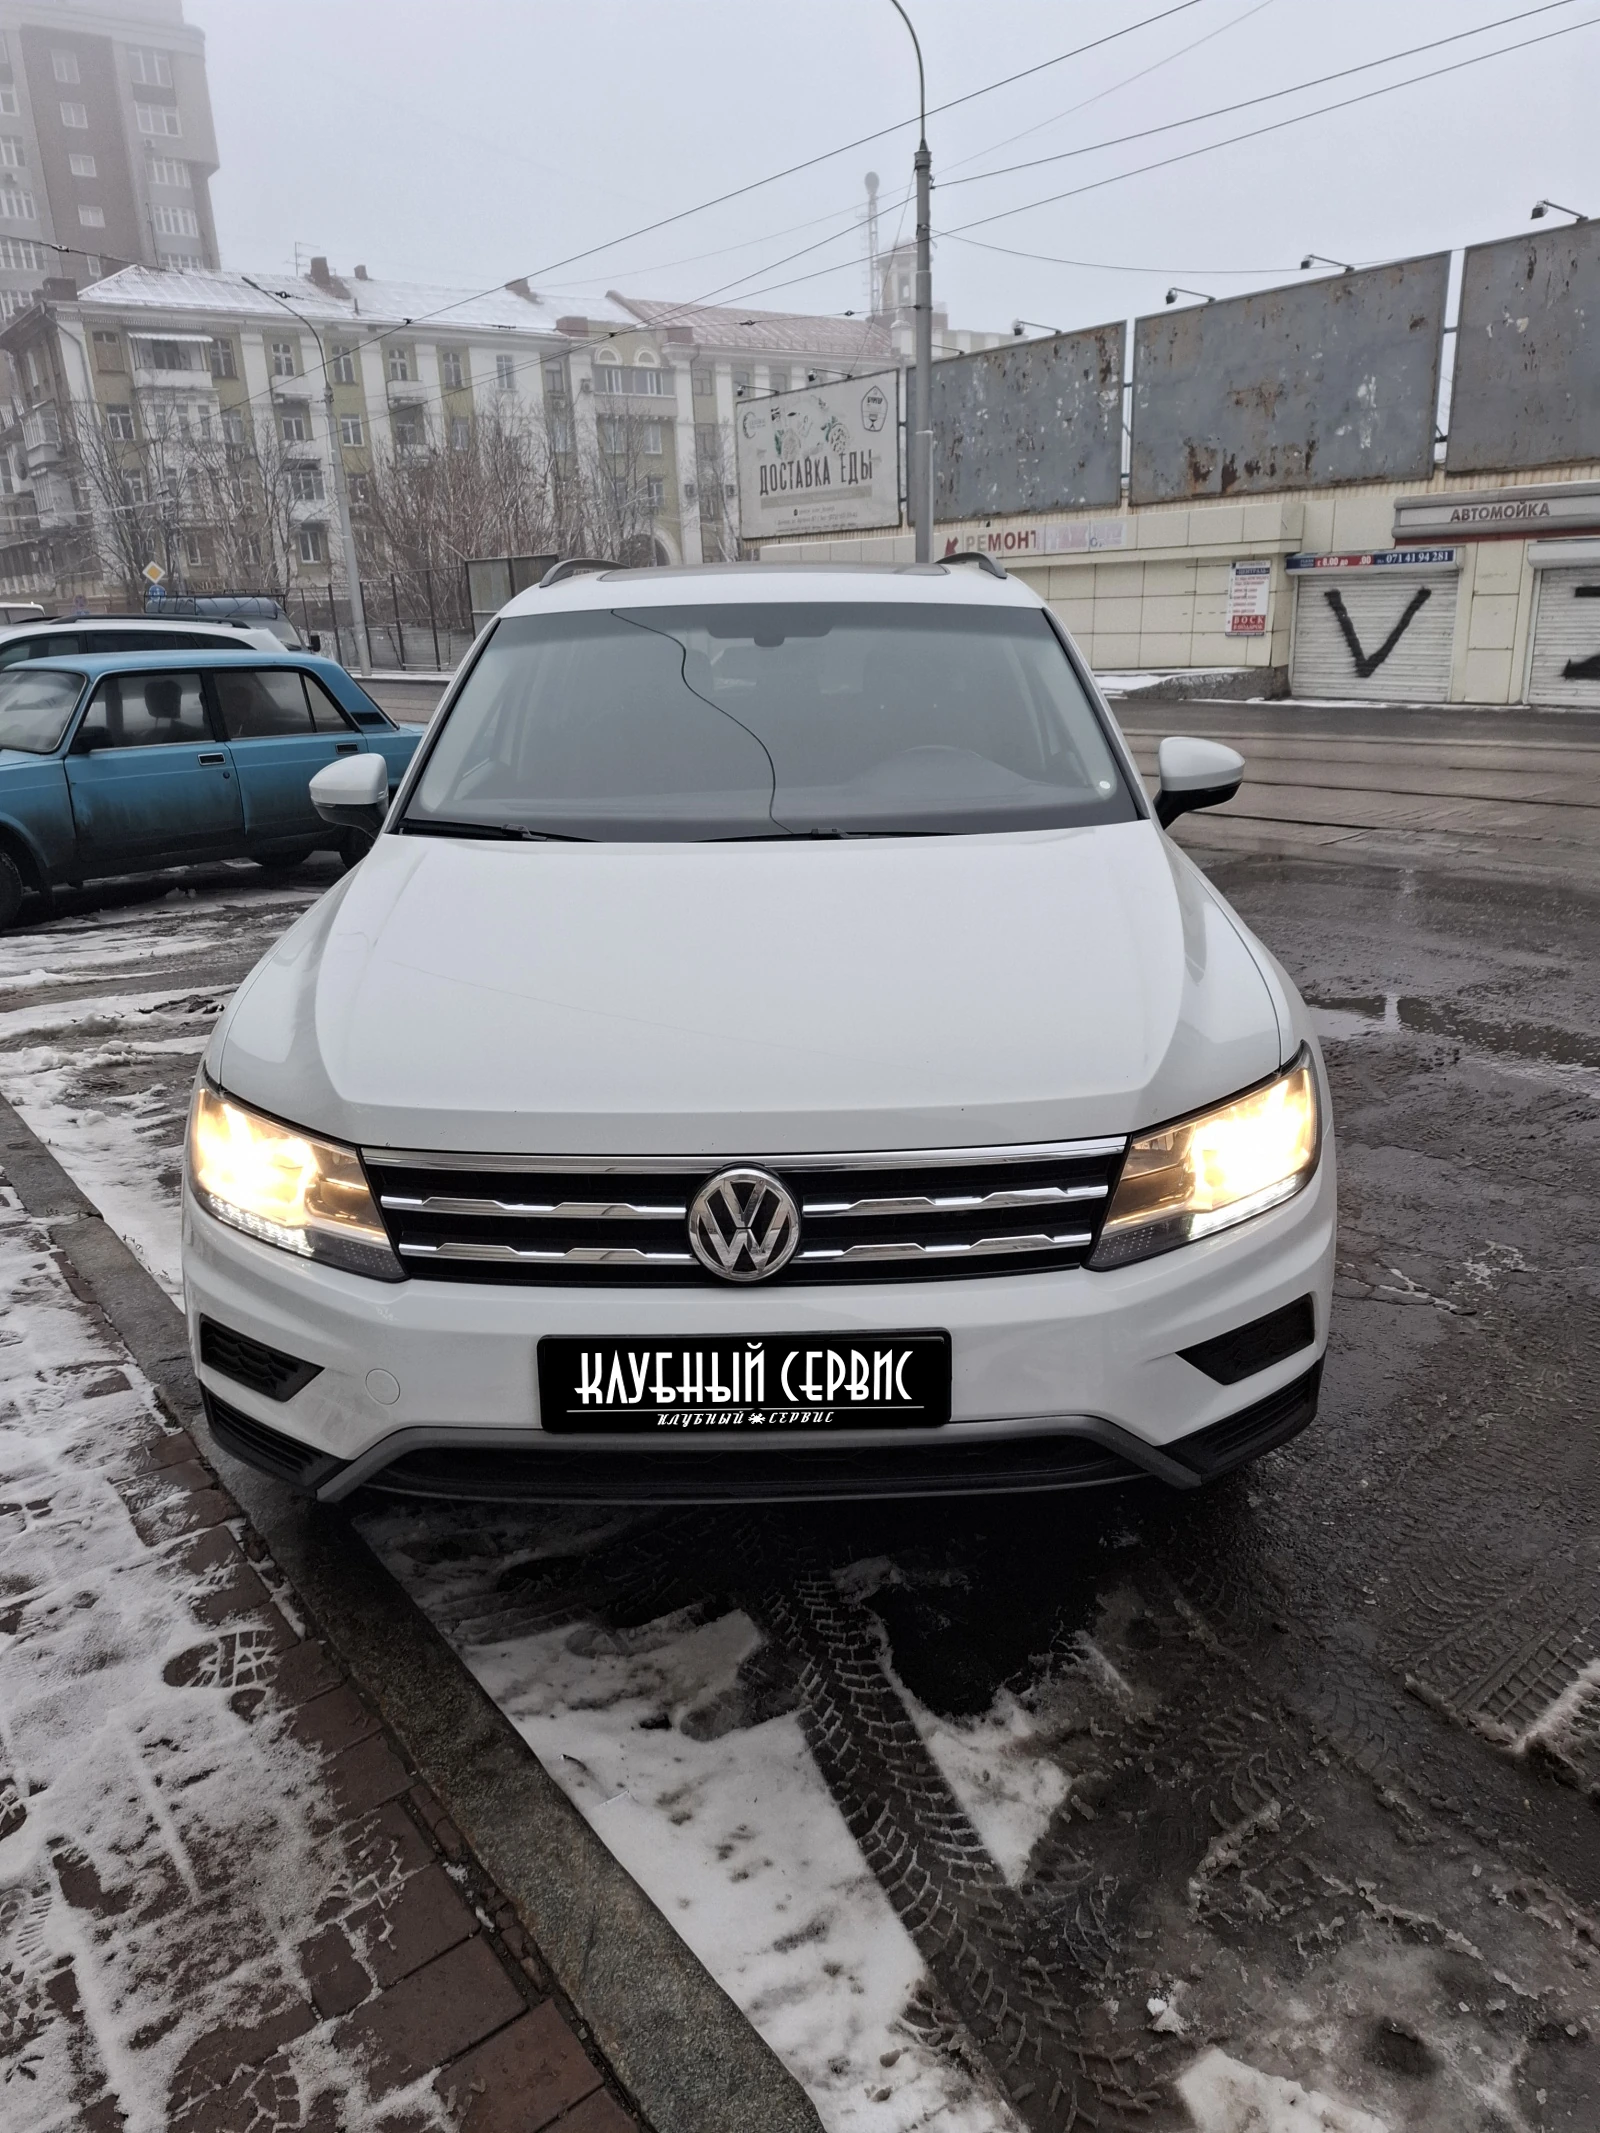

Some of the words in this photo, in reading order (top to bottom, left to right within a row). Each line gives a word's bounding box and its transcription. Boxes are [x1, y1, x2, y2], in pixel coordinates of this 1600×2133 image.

[759, 455, 831, 496] ДОСТАВКА
[839, 449, 873, 485] ЕДЫ
[1450, 500, 1550, 522] АВТОМОЙКА
[1386, 553, 1403, 564] 071
[1405, 552, 1416, 562] 41
[1418, 551, 1430, 562] 94
[1432, 551, 1449, 561] 281
[1233, 615, 1264, 624] ВОСК
